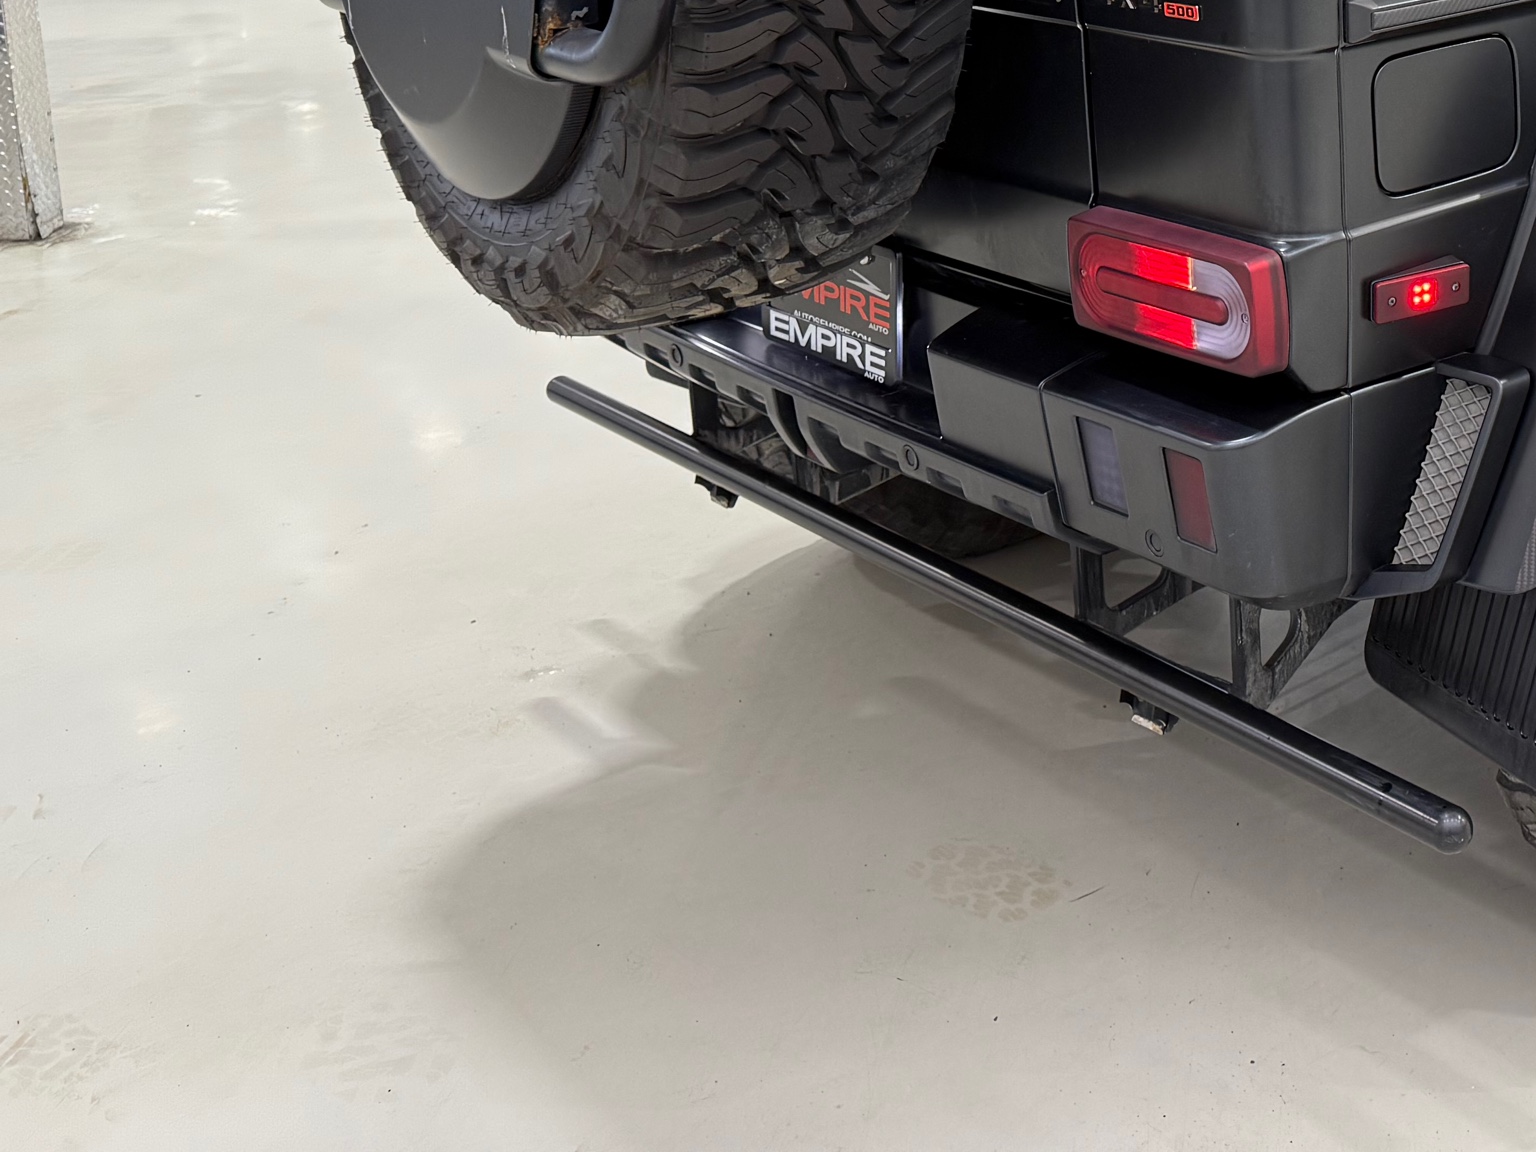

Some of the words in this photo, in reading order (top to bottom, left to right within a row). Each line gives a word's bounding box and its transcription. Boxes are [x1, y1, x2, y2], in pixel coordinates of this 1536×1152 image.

[1166, 4, 1195, 19] 500
[868, 322, 889, 335] AUTO
[769, 309, 886, 378] EMPIRE
[864, 370, 885, 384] AUTO
